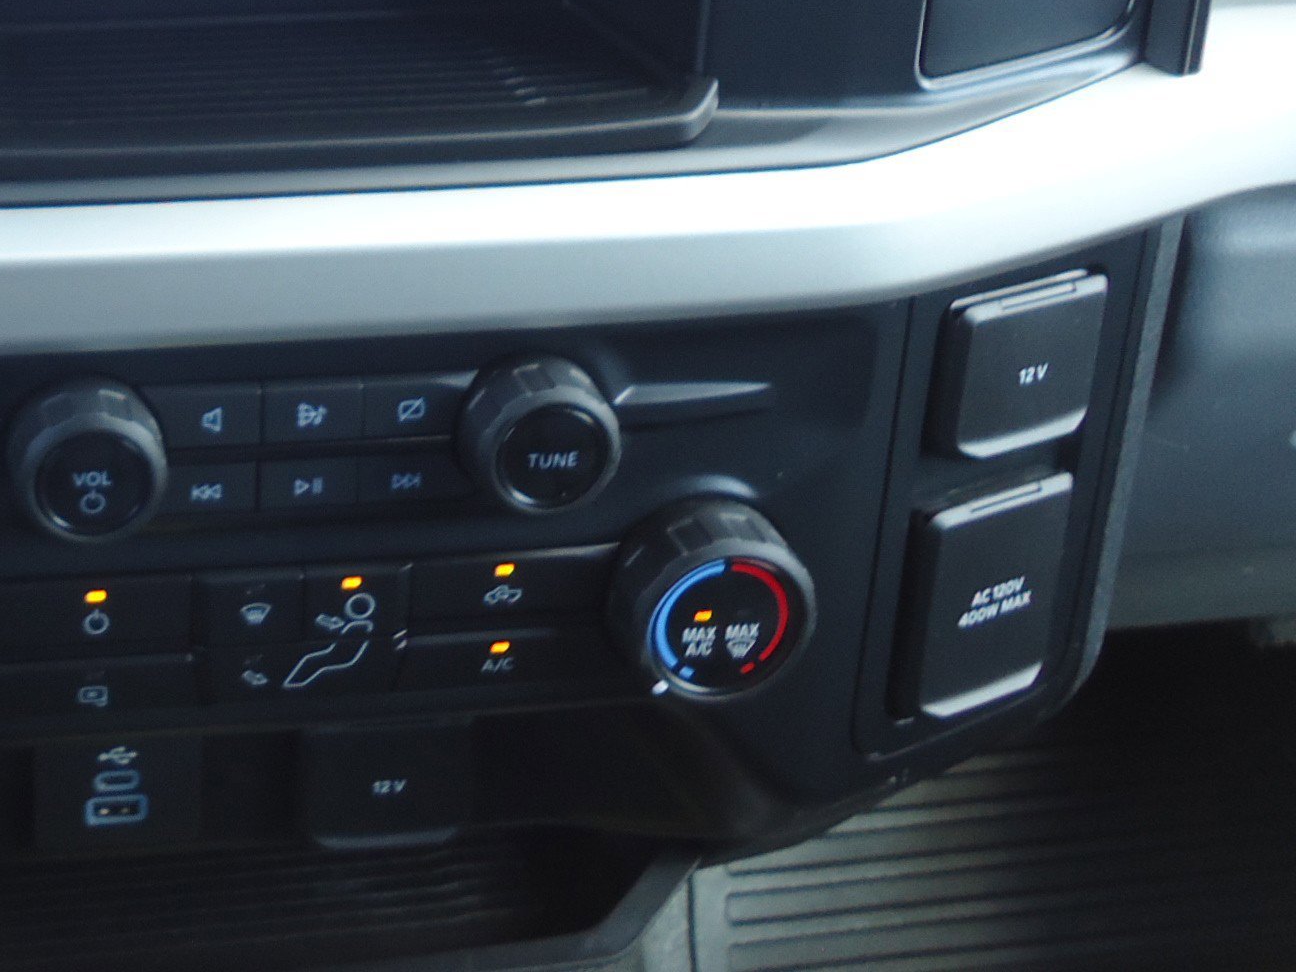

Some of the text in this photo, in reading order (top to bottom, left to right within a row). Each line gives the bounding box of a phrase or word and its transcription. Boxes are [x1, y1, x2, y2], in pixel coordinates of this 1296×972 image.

[527, 450, 580, 469] TUNE
[72, 470, 112, 487] VOL
[999, 590, 1032, 614] MAX
[682, 626, 716, 643] MAX
[724, 622, 760, 641] MAX
[684, 641, 714, 658] A/C
[481, 657, 513, 673] A/C
